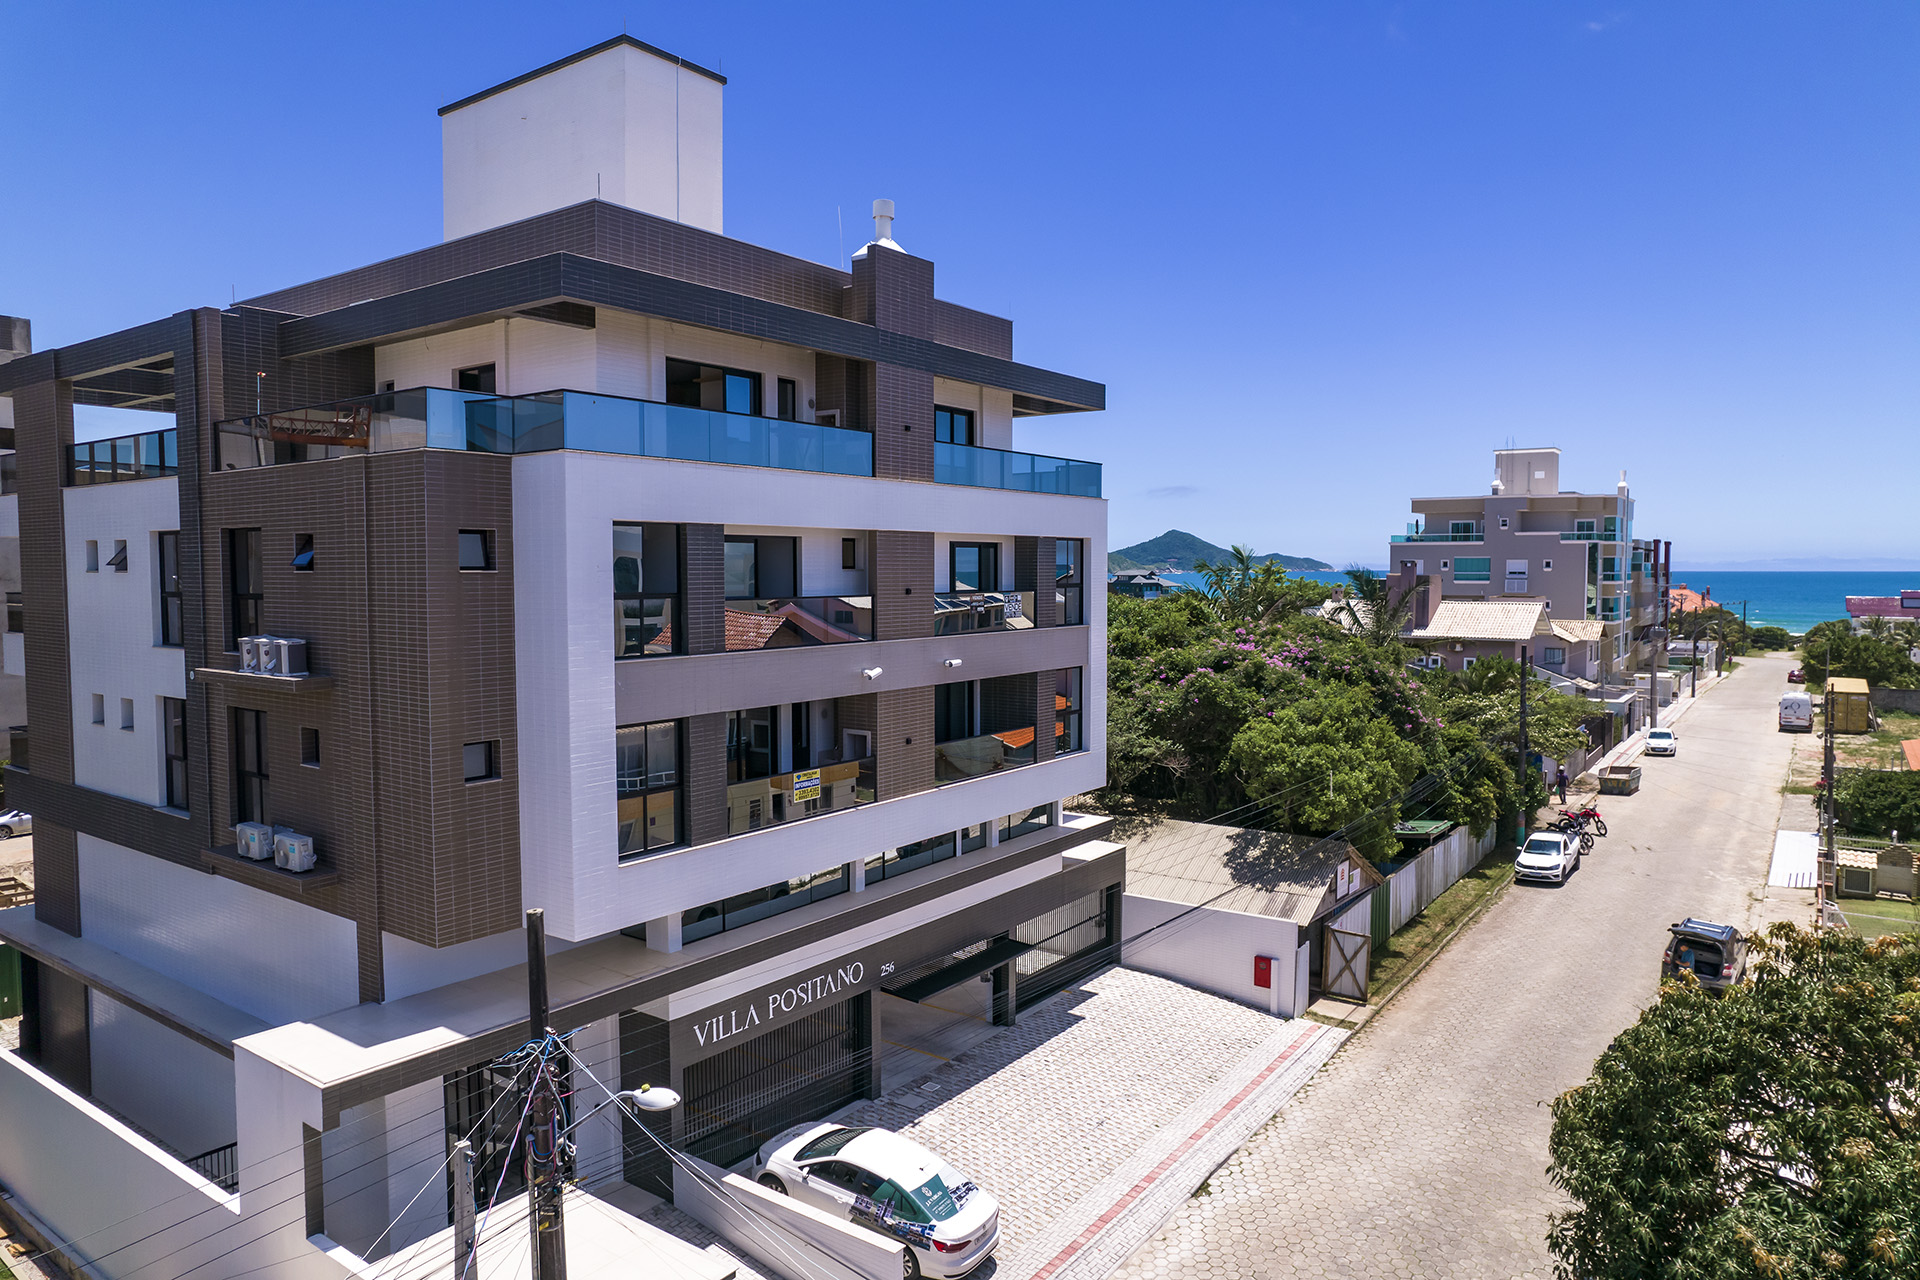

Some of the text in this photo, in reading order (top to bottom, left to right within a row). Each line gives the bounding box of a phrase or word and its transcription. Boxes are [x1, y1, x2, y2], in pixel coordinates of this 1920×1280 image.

[880, 961, 895, 977] 256
[693, 961, 864, 1047] VILLA POSITANO
